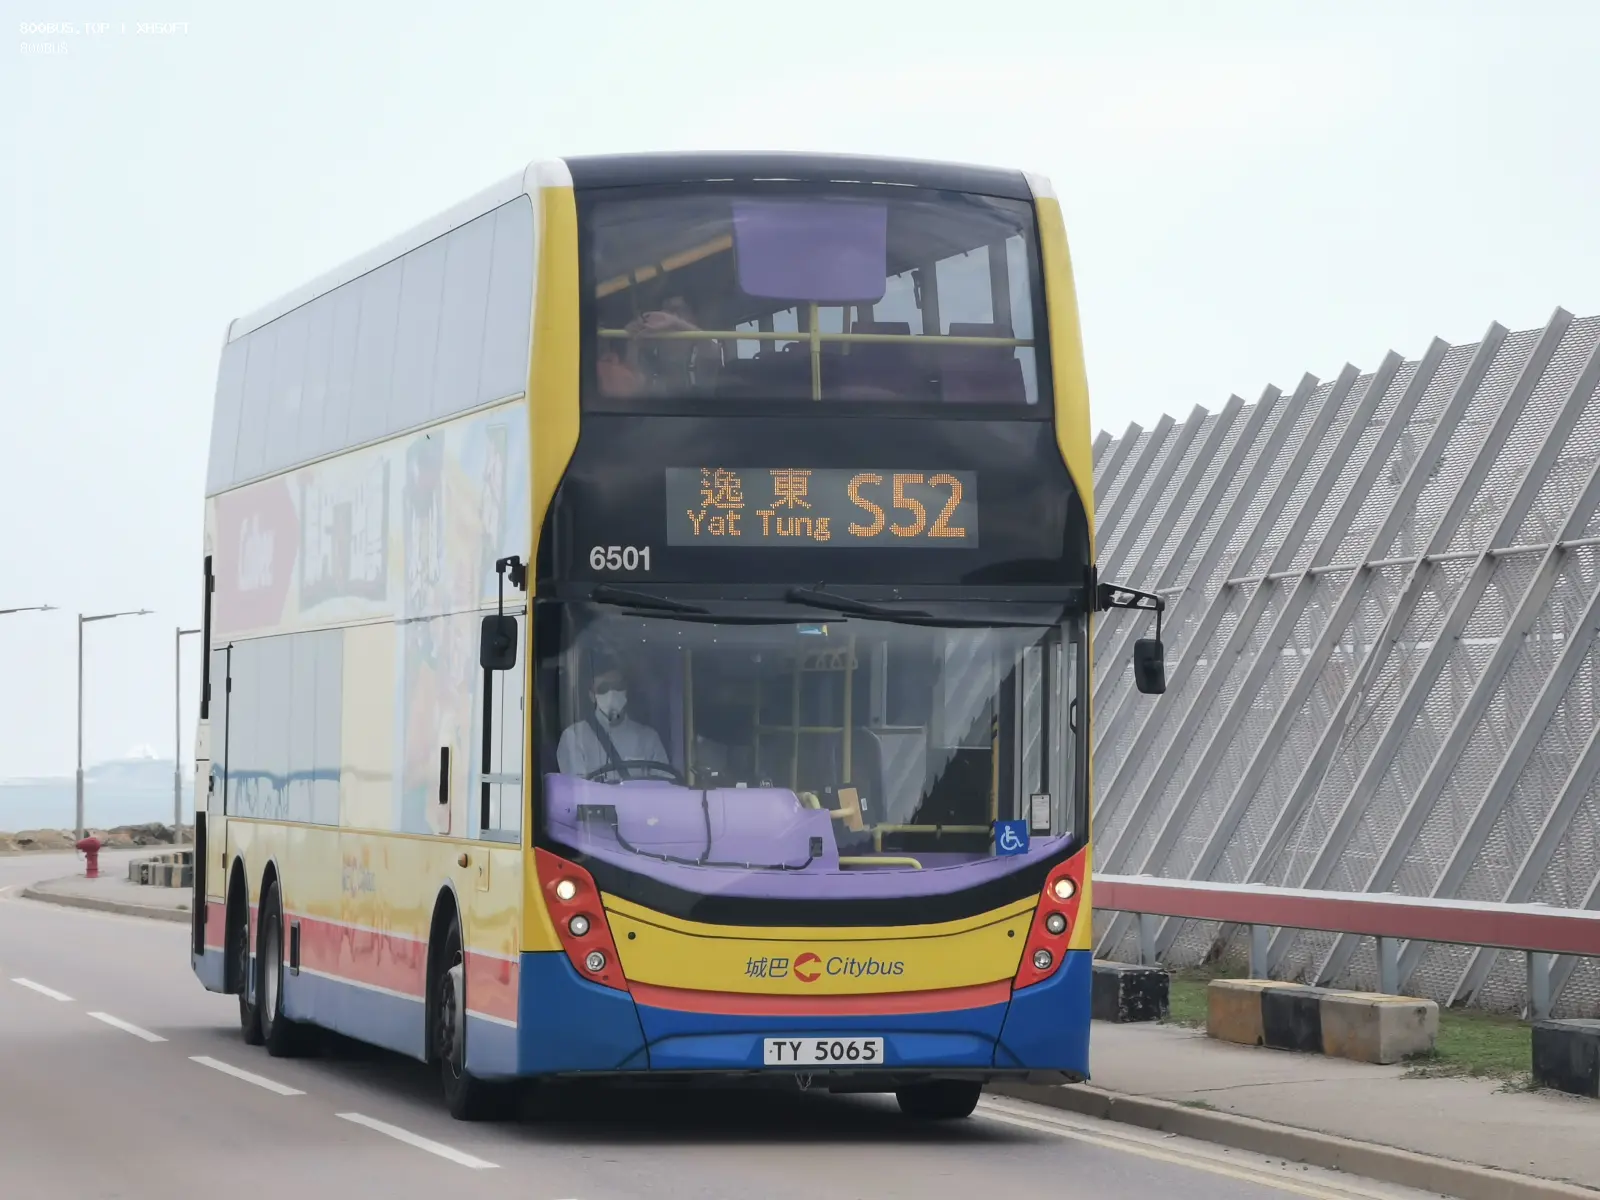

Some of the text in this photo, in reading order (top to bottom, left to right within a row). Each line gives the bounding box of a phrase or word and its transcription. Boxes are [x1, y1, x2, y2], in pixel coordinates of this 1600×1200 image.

[847, 473, 967, 538] S52
[686, 509, 832, 542] Yat Tung
[589, 546, 652, 571] 6501
[744, 956, 789, 978] 城巴
[826, 957, 905, 977] Citybus
[772, 1041, 876, 1061] TY 5065
